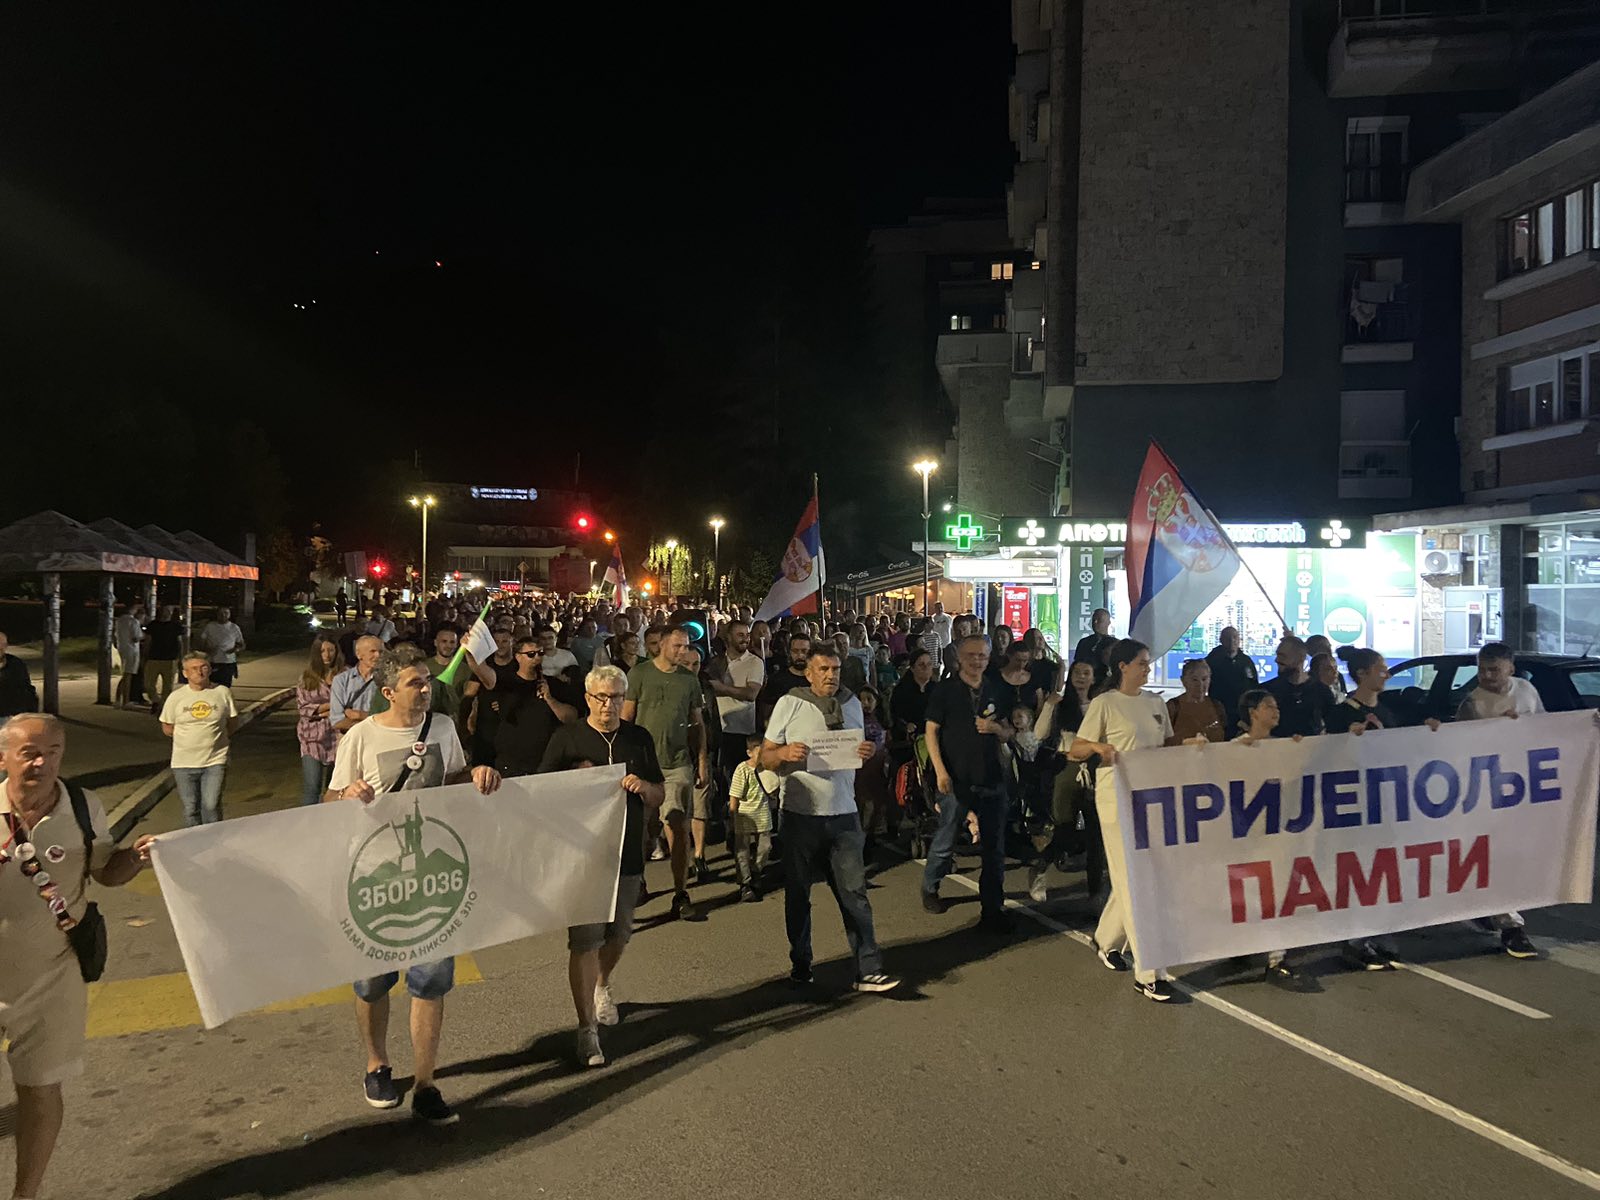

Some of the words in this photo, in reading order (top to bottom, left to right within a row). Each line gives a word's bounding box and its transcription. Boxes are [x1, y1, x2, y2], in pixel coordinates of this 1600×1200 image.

[1059, 523, 1127, 542] АПОТ
[1079, 547, 1094, 638] ПОТЕК
[1295, 548, 1313, 635] ПОТЕК
[1132, 747, 1562, 850] ПРИЈЕПОЉЕ
[357, 877, 418, 911] ЗБОР
[1227, 834, 1490, 924] ПАМТИ
[340, 918, 365, 952] НАМА
[366, 946, 407, 962] ДОБРО
[419, 918, 462, 956] НИКОМЕ
[461, 890, 478, 919] ЗЛО
